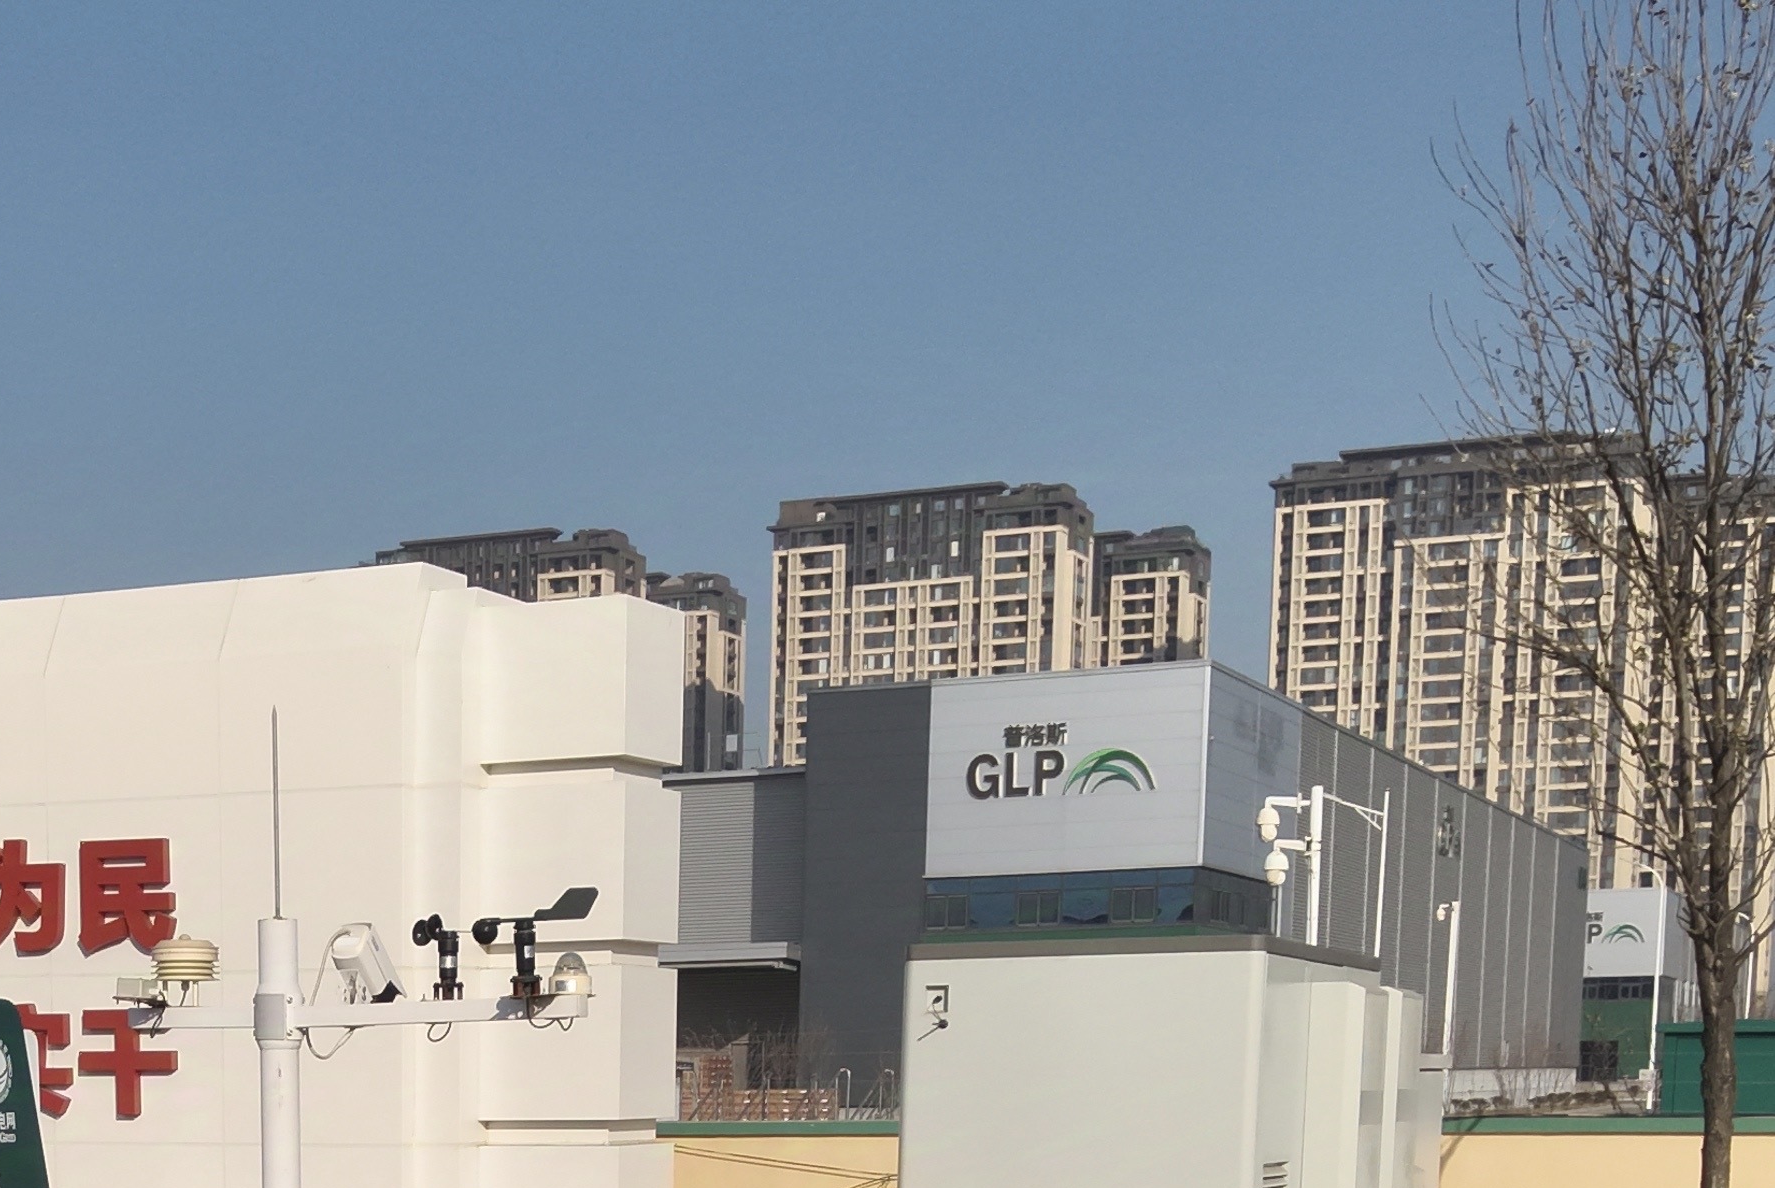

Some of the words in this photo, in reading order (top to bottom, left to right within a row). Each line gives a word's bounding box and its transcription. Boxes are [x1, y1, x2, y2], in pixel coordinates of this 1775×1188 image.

[1003, 722, 1067, 748] 普洛斯
[966, 750, 1065, 800] GLP
